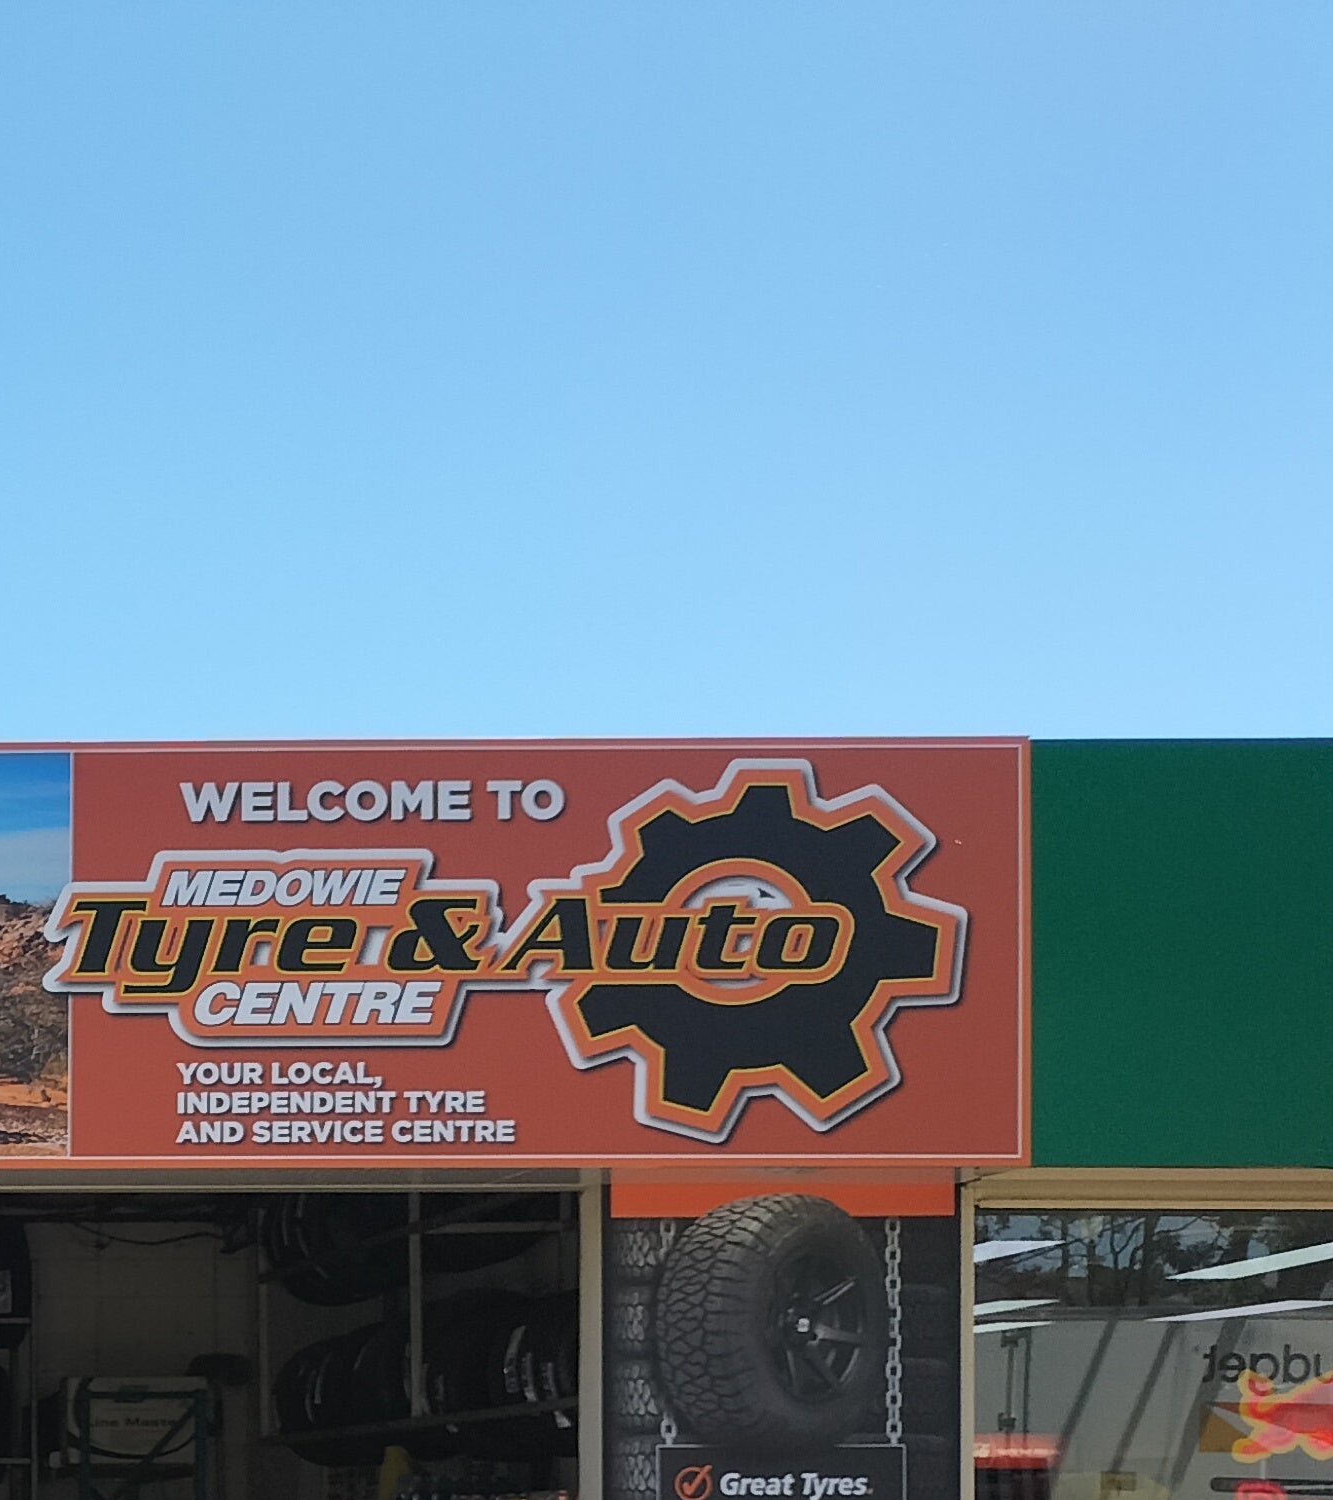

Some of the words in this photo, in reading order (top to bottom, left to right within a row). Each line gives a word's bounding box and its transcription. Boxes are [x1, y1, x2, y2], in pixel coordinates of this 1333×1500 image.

[180, 780, 472, 822] WELCOME
[487, 779, 564, 820] TO
[161, 868, 406, 907] MEDOWIE
[71, 898, 358, 995] Tyre
[386, 897, 481, 973] &
[501, 896, 839, 974] Auto
[194, 981, 442, 1026] CENTRE
[176, 1062, 263, 1085] YOUR
[271, 1062, 383, 1089] LOCAL,
[177, 1091, 396, 1114] INDEPENDENT
[403, 1091, 486, 1113] TYRE
[176, 1121, 245, 1143] AND
[252, 1120, 385, 1143] SERVICE
[392, 1120, 516, 1143] CENTRE
[719, 1473, 794, 1496] Great
